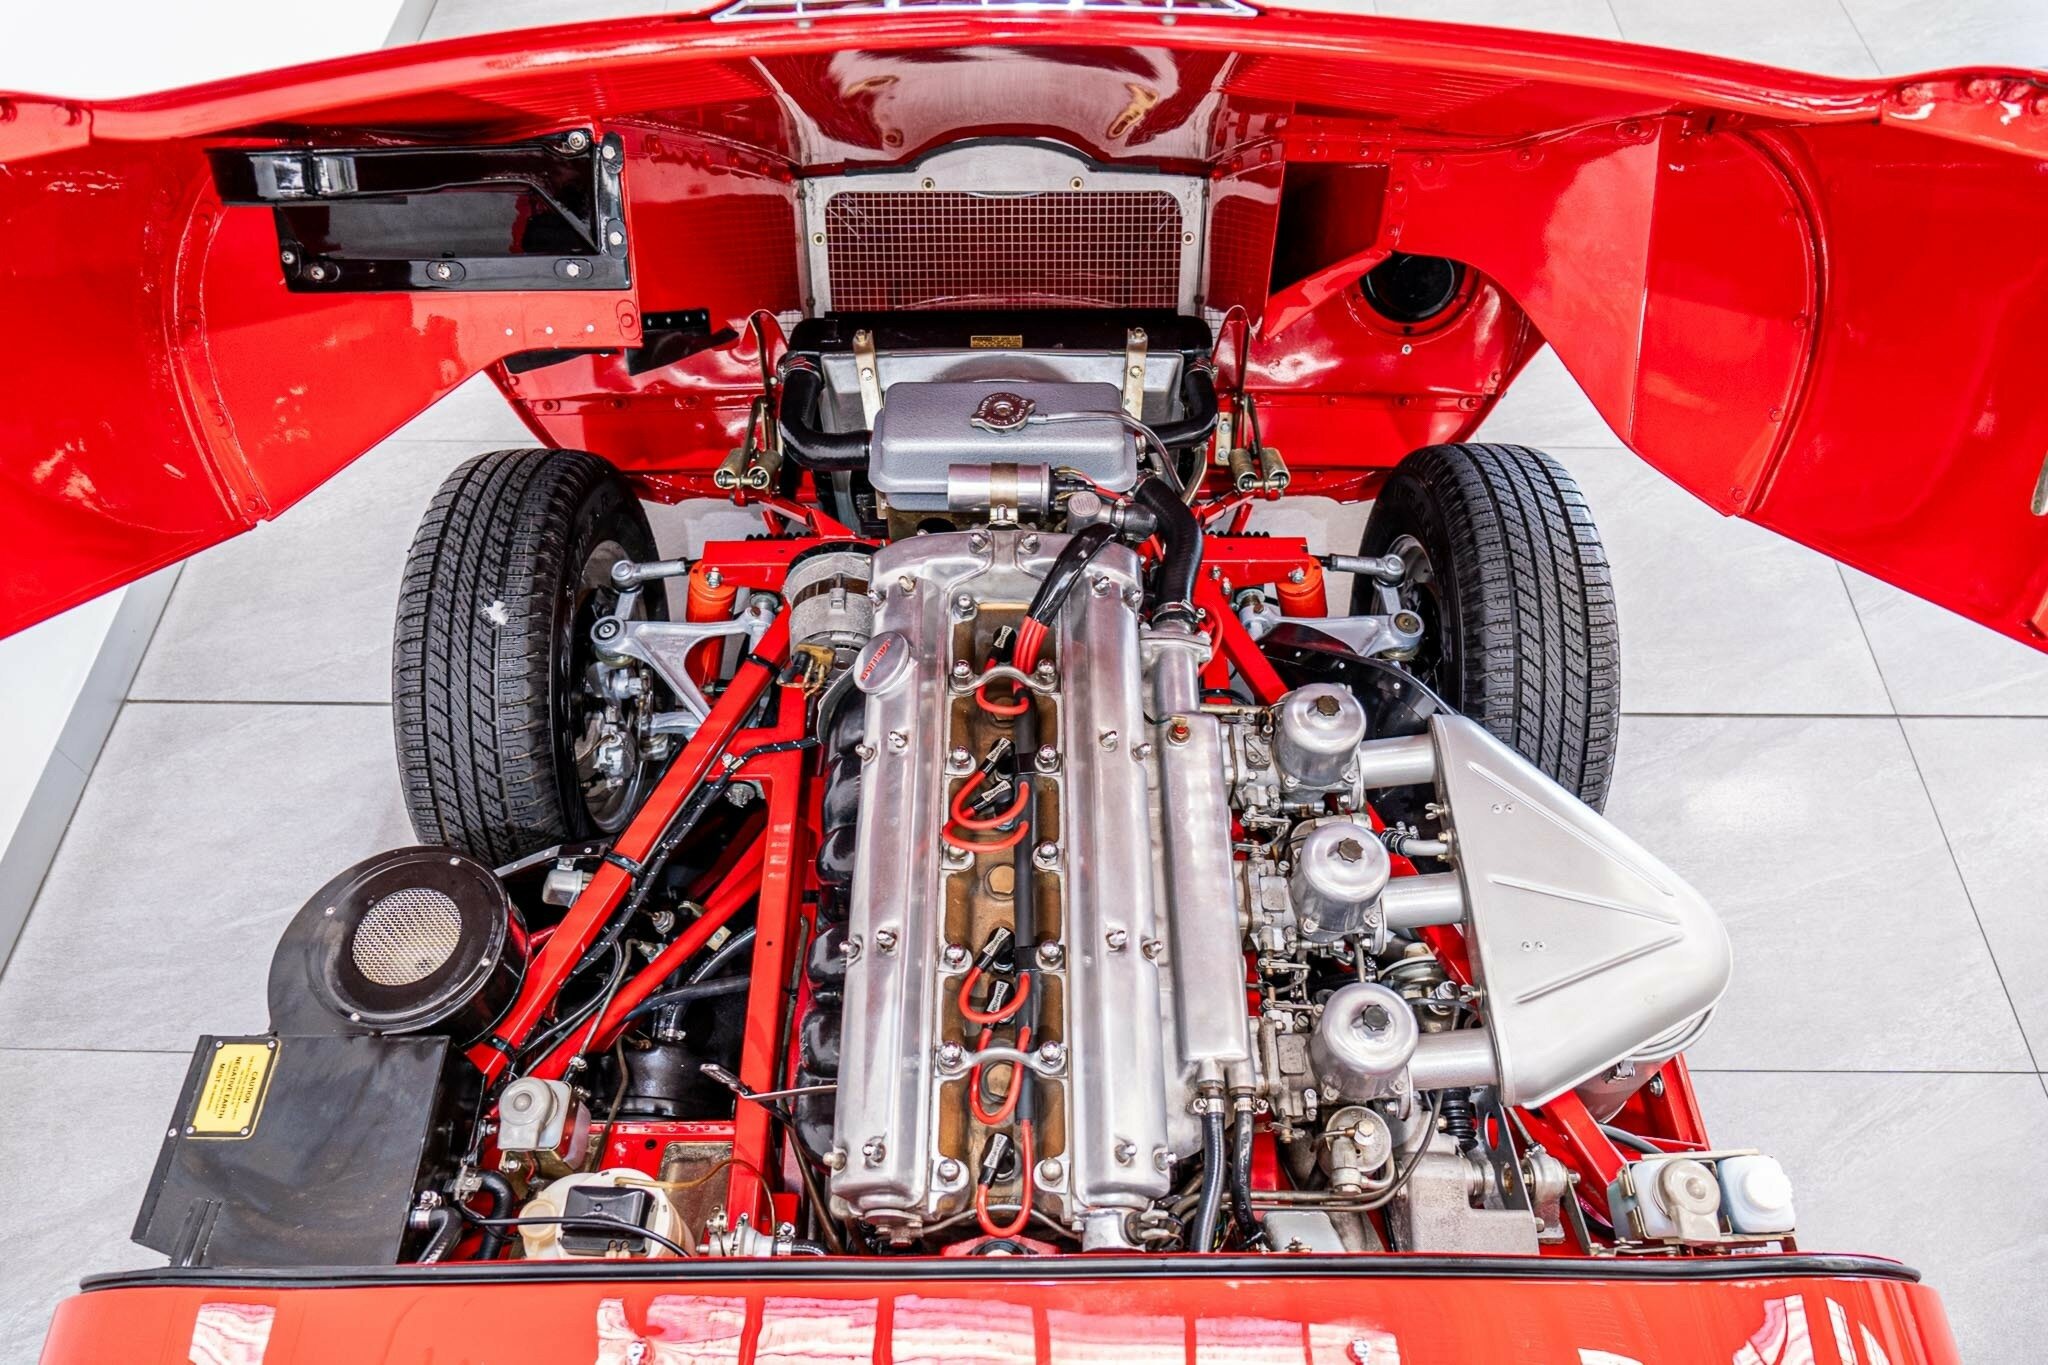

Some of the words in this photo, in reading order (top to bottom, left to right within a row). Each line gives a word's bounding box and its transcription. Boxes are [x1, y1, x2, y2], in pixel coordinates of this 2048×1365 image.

[984, 782, 1009, 799] CHAMPION
[986, 929, 1007, 954] CHAMPION
[215, 1063, 225, 1082] MUST
[227, 1056, 242, 1090] NEGATIVE
[244, 1071, 258, 1103] CAUTION
[217, 1092, 230, 1119] EARTH
